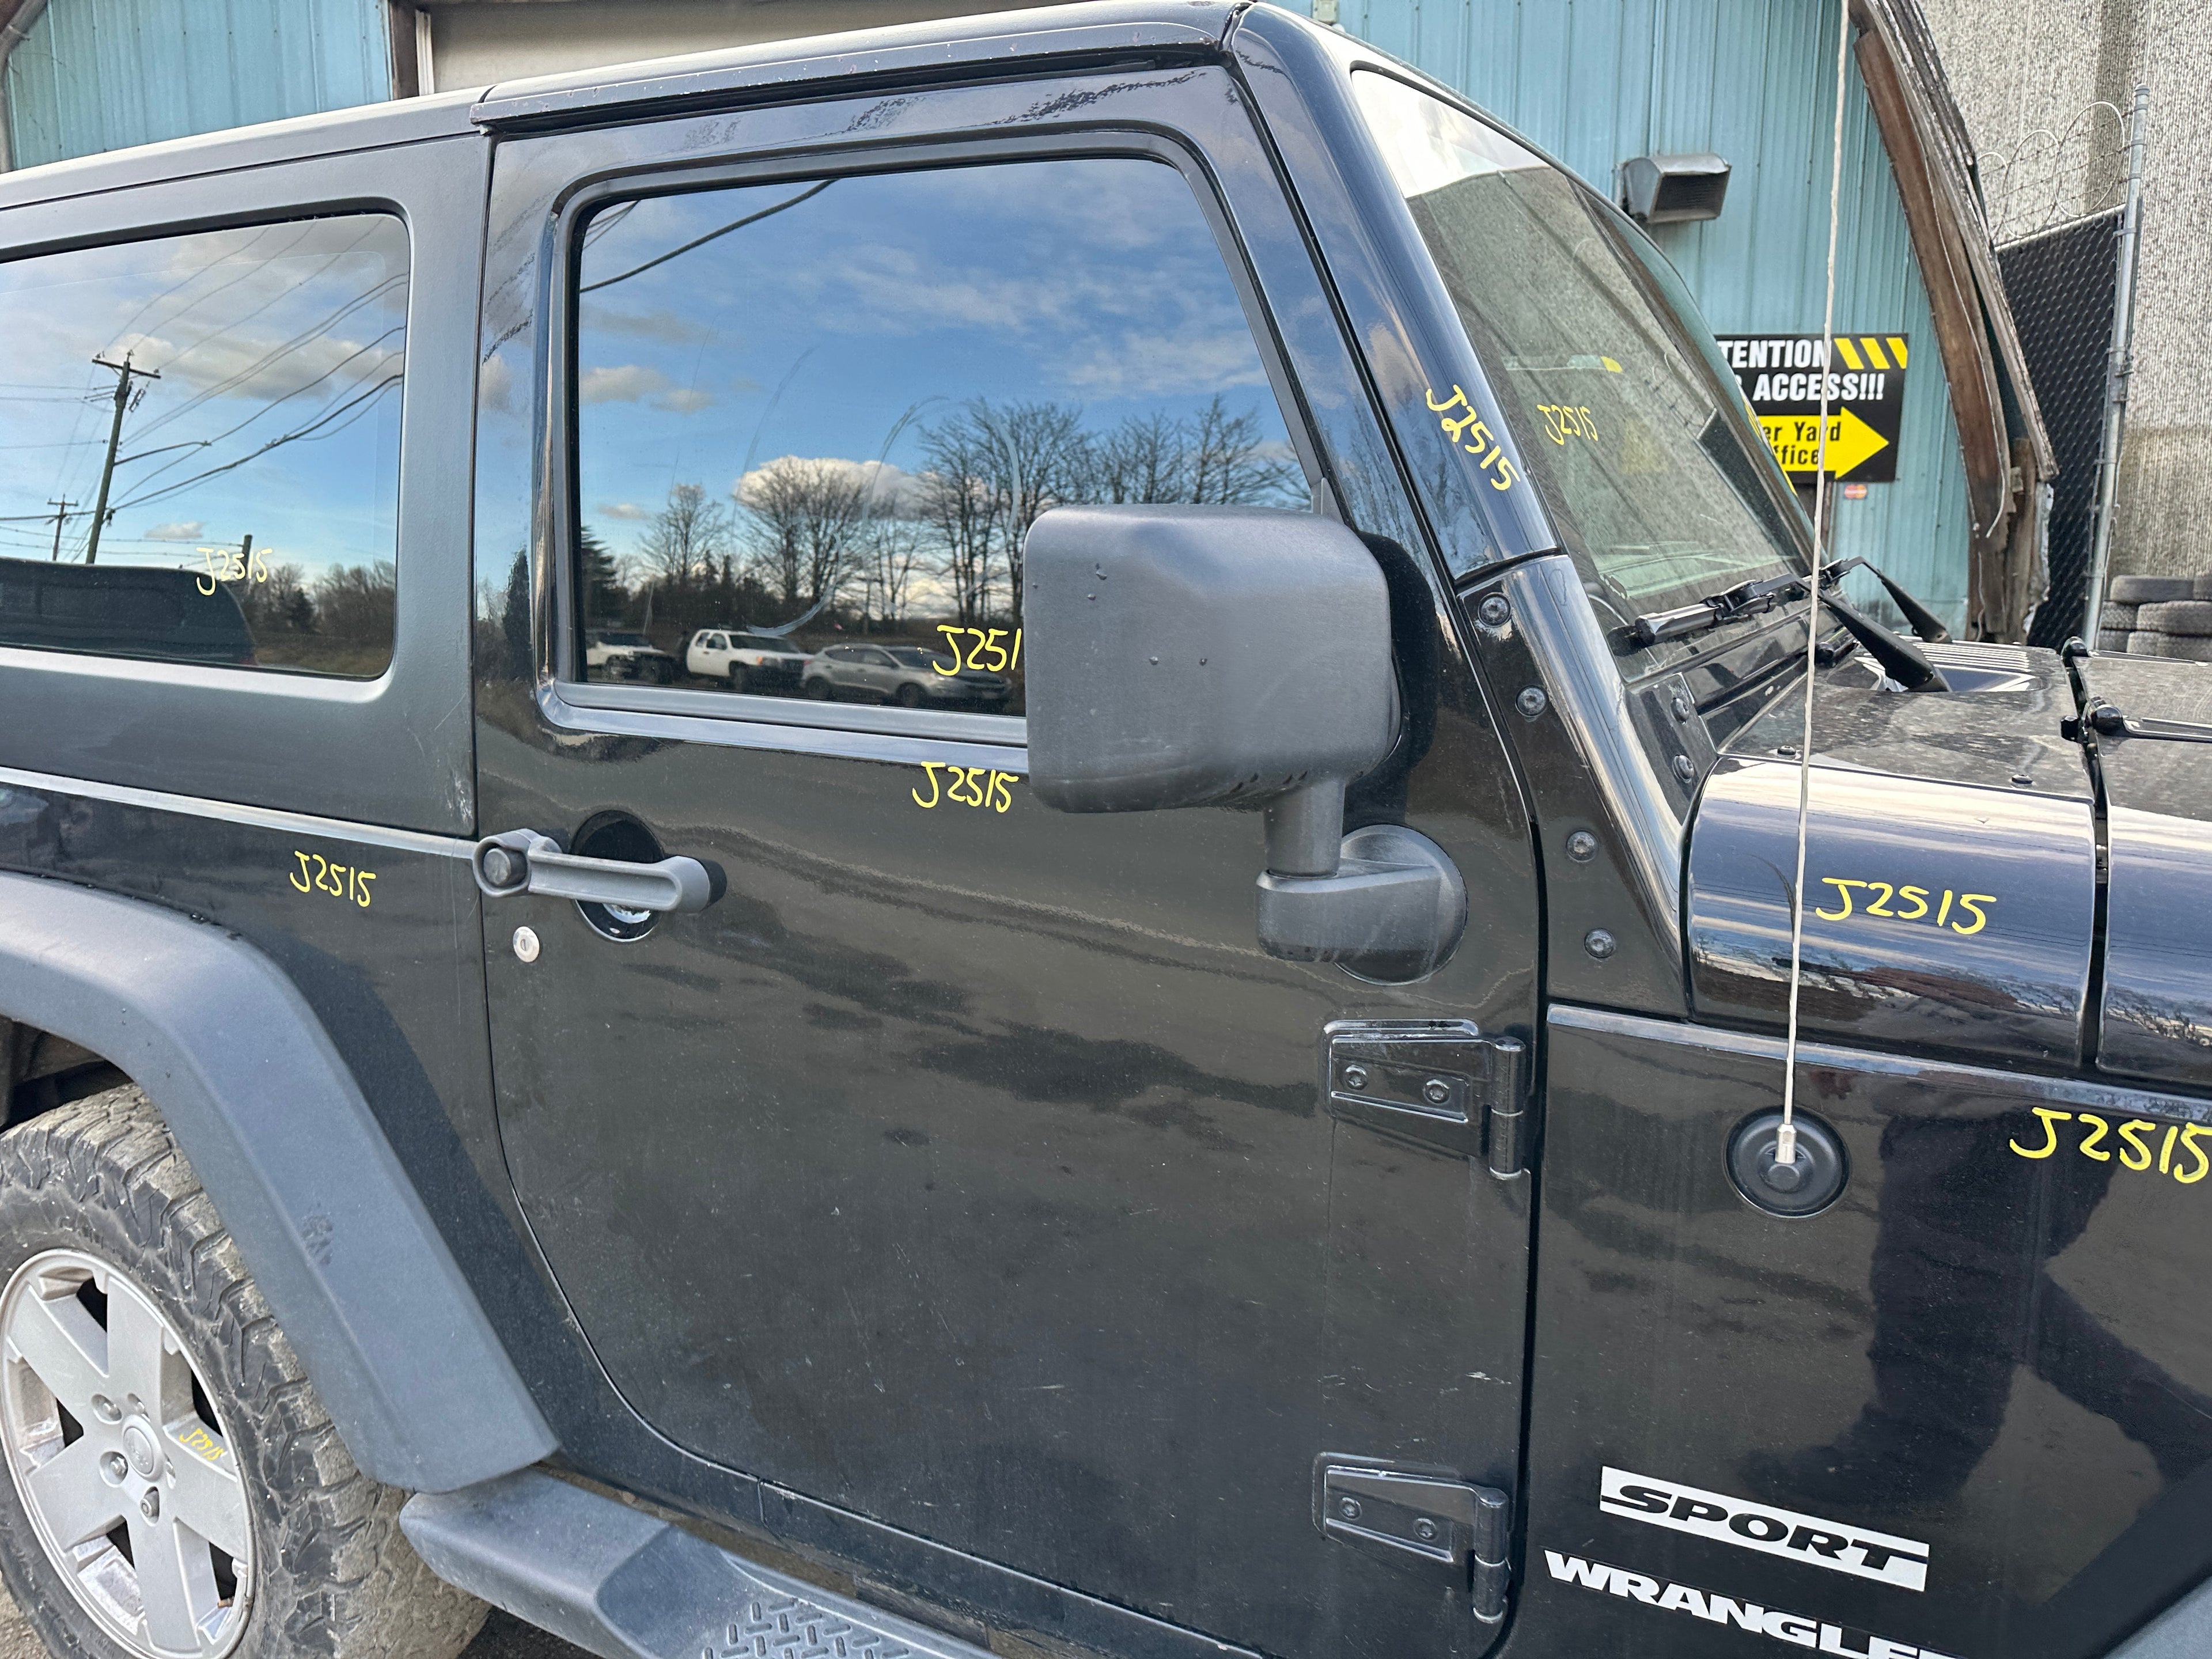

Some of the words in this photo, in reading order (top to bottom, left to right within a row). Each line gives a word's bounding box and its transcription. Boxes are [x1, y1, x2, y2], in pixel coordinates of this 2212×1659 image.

[1752, 373, 1884, 402] ACCESS!!!
[1426, 384, 1520, 490] J2515
[1537, 404, 1598, 445] J2515
[1794, 421, 1841, 442] Yad
[196, 547, 272, 596] J2515
[912, 761, 1019, 813] J2515
[290, 850, 376, 907] J2515
[1816, 877, 1997, 934] J2515
[2009, 1107, 2212, 1184] J2515
[1618, 1484, 1906, 1571] SPORT
[1544, 1549, 1960, 1659] WRANGLE
